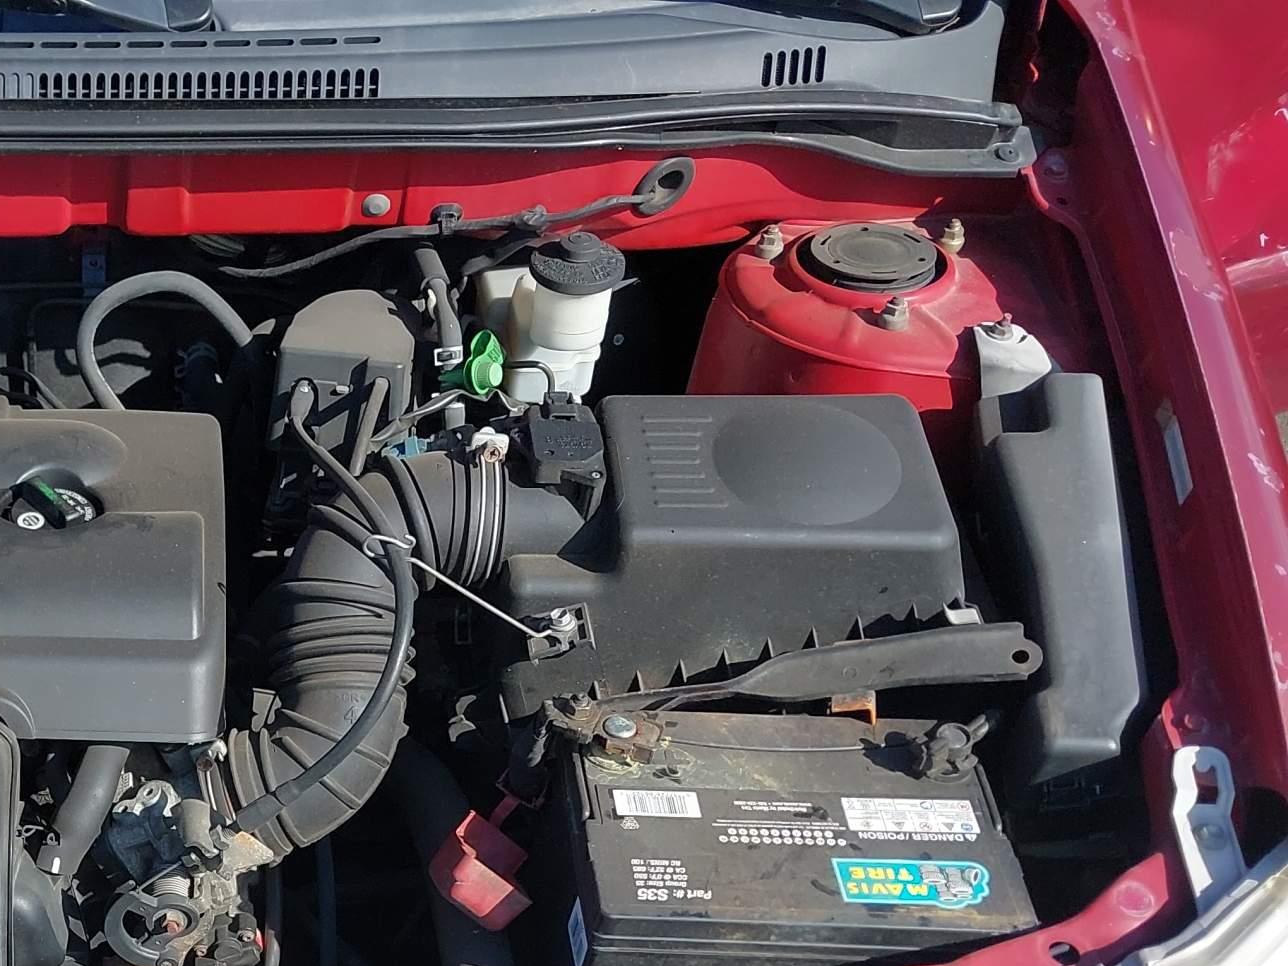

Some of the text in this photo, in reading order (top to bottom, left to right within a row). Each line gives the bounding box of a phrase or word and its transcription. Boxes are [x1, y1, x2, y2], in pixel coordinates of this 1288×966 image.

[858, 831, 904, 840] POISON
[912, 832, 965, 842] DANGER
[848, 866, 914, 881] TIRE
[637, 888, 712, 901] Part #: S35
[846, 882, 930, 897] MAVIS
